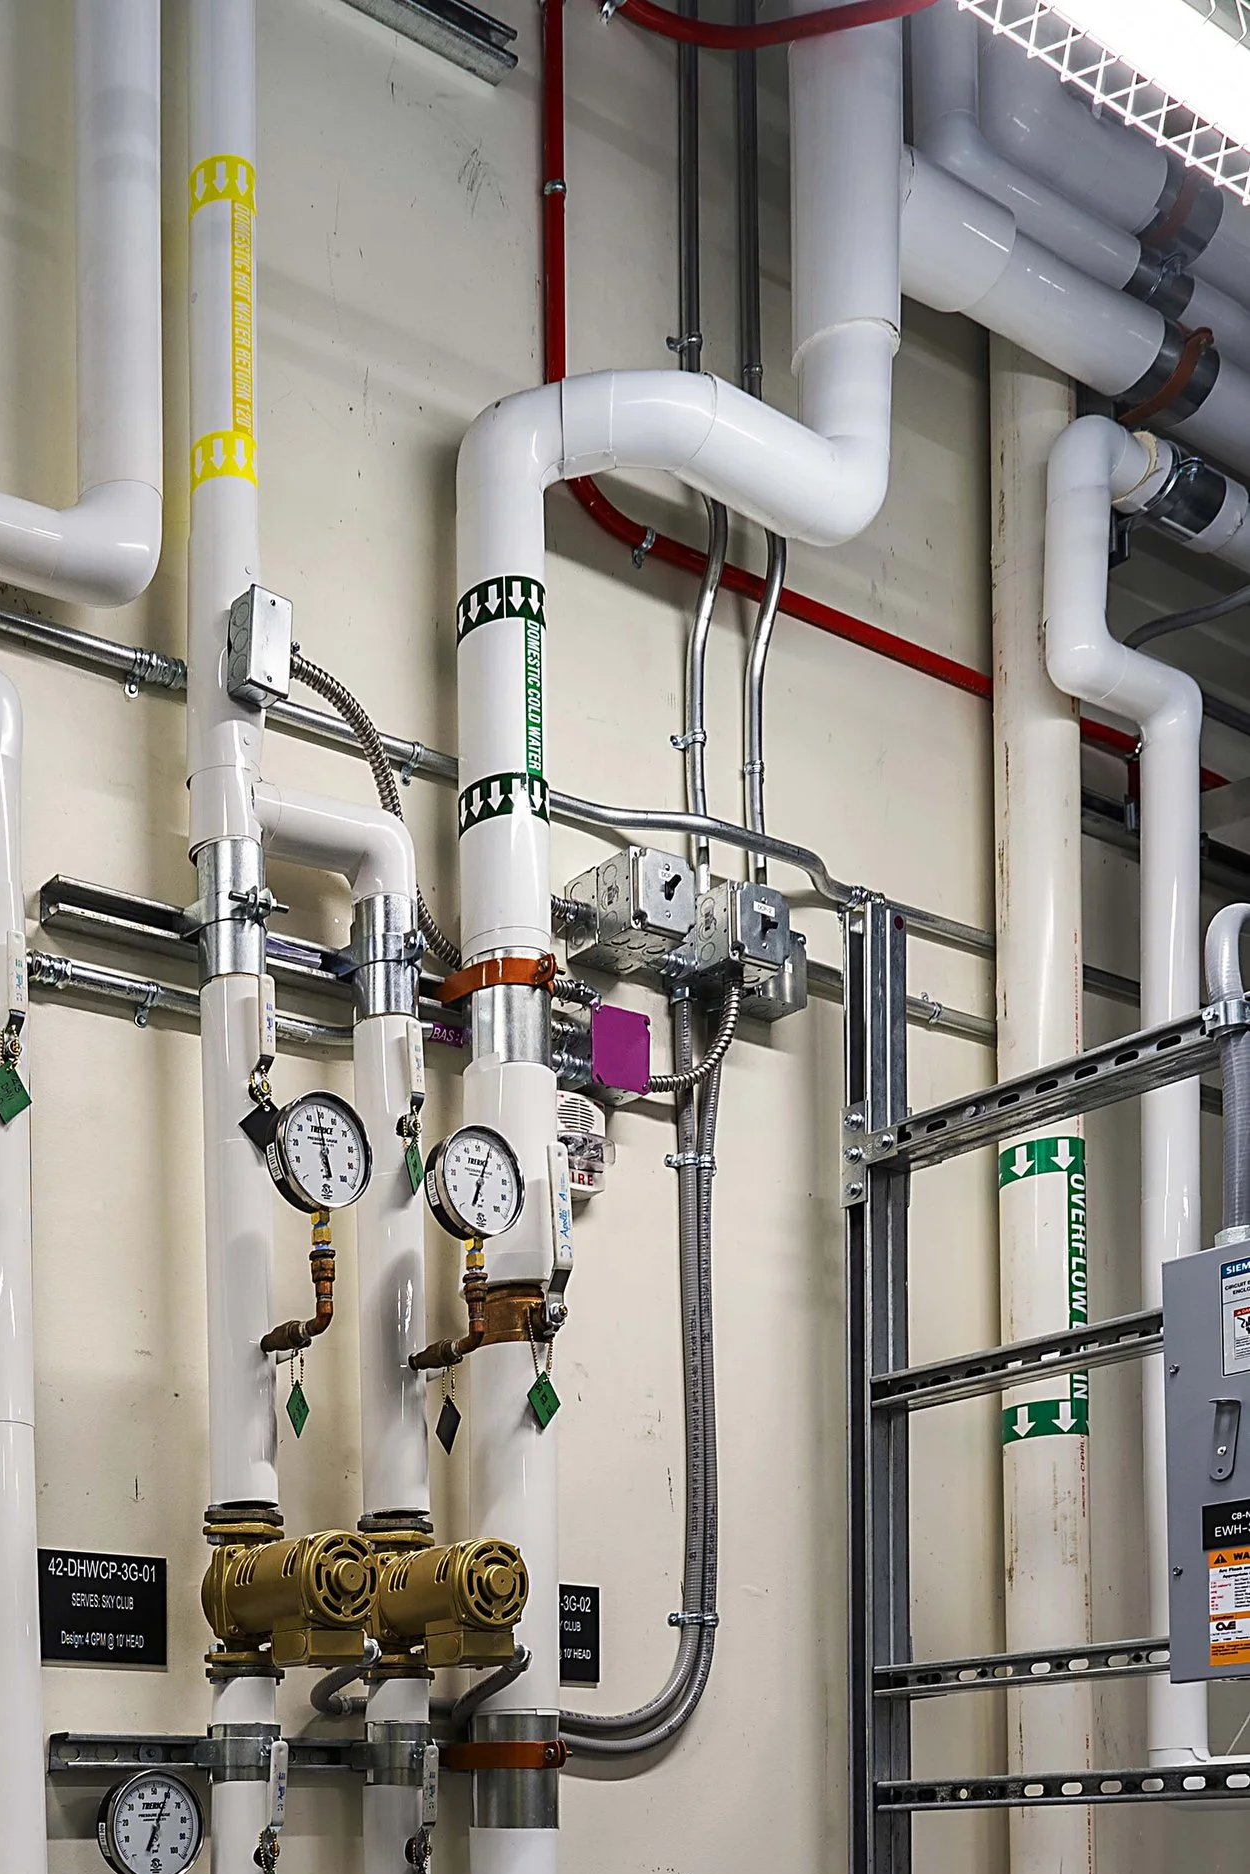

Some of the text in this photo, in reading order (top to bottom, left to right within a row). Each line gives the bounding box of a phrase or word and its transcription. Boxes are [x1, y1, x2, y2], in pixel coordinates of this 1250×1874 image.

[234, 202, 250, 270] DOMESTIC
[234, 269, 250, 301] HOT
[234, 301, 250, 349] WATER
[234, 349, 251, 400] RETURN
[526, 619, 541, 771] DOMESTIC COLD WATER
[432, 1026, 463, 1045] BAS:
[571, 1172, 594, 1186] IRE
[1070, 1173, 1087, 1314] OVERFLOW
[48, 1557, 156, 1582] 42-DHWCP-3G-01
[71, 1592, 134, 1610] SERVES: SKY CLUB
[563, 1620, 581, 1632] CLUB
[61, 1630, 84, 1648] Design:
[91, 1632, 106, 1646] GPM
[107, 1633, 114, 1650] @
[126, 1634, 145, 1649] HEAD
[573, 1648, 592, 1660] HEAD
